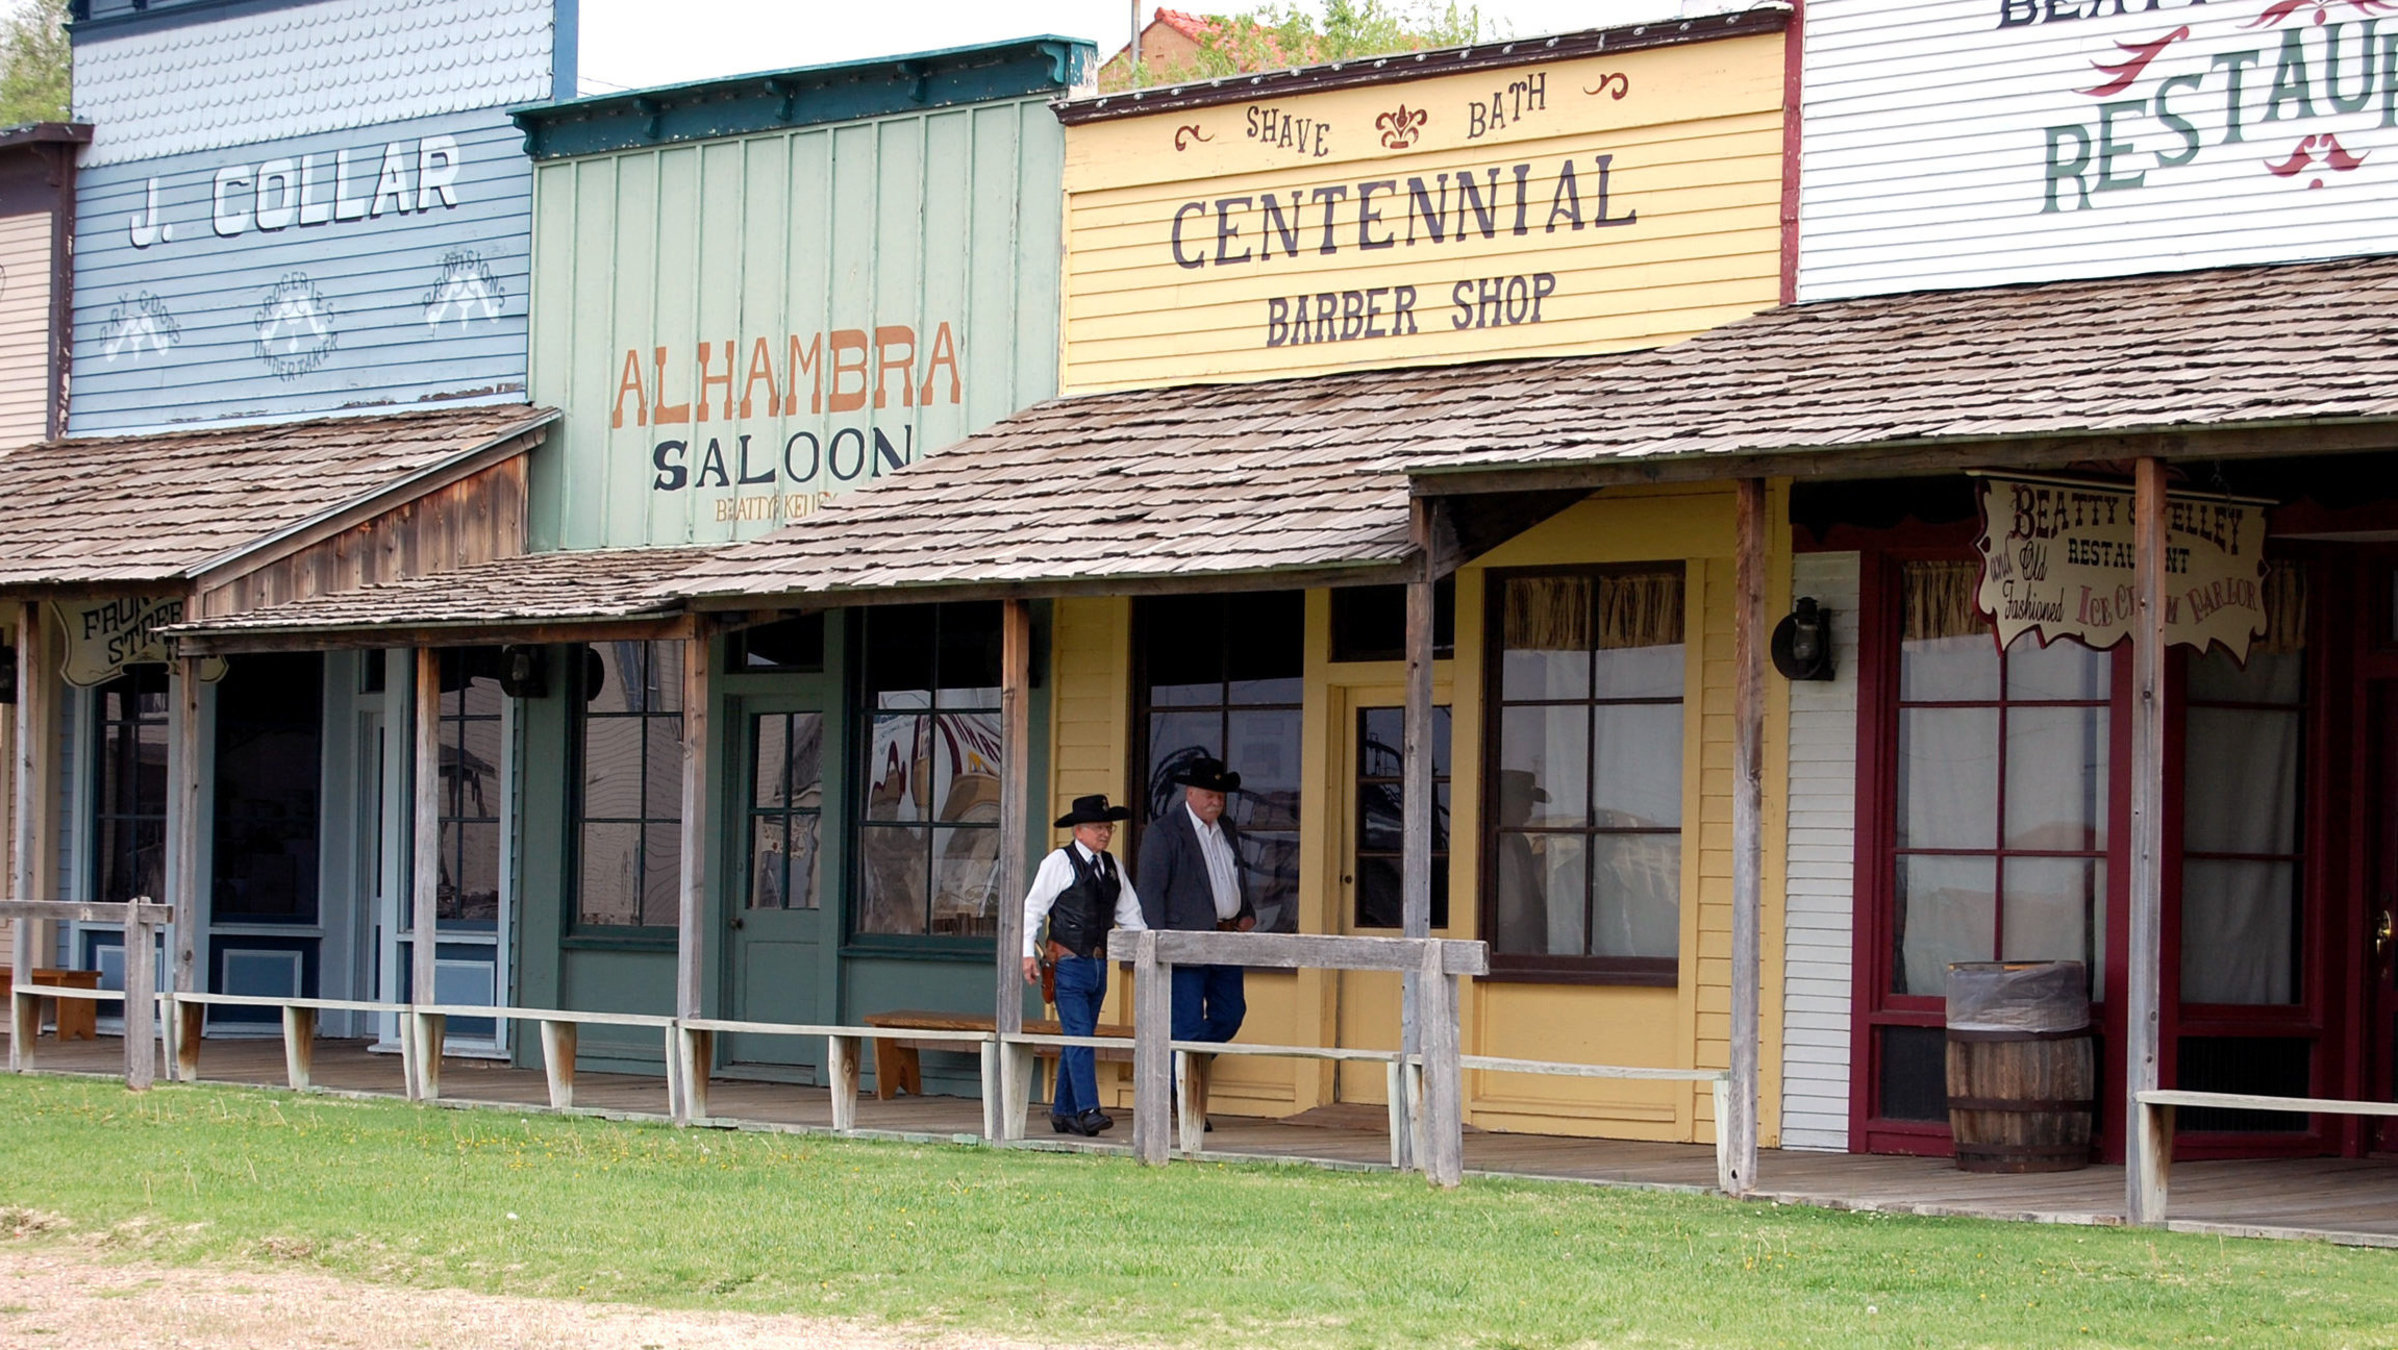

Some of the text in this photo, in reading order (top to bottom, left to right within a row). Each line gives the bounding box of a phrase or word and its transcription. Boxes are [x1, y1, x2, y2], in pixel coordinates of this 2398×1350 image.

[1246, 72, 1547, 158] SHAVE BATH
[129, 133, 461, 249] J. COLLAR
[1170, 154, 1638, 270] CENTENNIAL
[254, 271, 336, 331] GROCERIES
[422, 250, 507, 316] PROVISIONS
[1267, 272, 1556, 348] BARBER SHOP
[99, 289, 182, 348] DRY GOODS
[253, 331, 339, 383] UNDERTAKER
[612, 321, 962, 429] ALHAMBRA
[653, 424, 913, 491] SALOON
[2010, 482, 2119, 540] BEATTY
[2163, 502, 2243, 555] ELLEY
[1990, 533, 2048, 584] and Old
[2068, 538, 2190, 574] RESTAUNT
[2002, 579, 2065, 622] Fashioned
[2076, 585, 2113, 627] ICE
[2186, 577, 2258, 625] PARLOR
